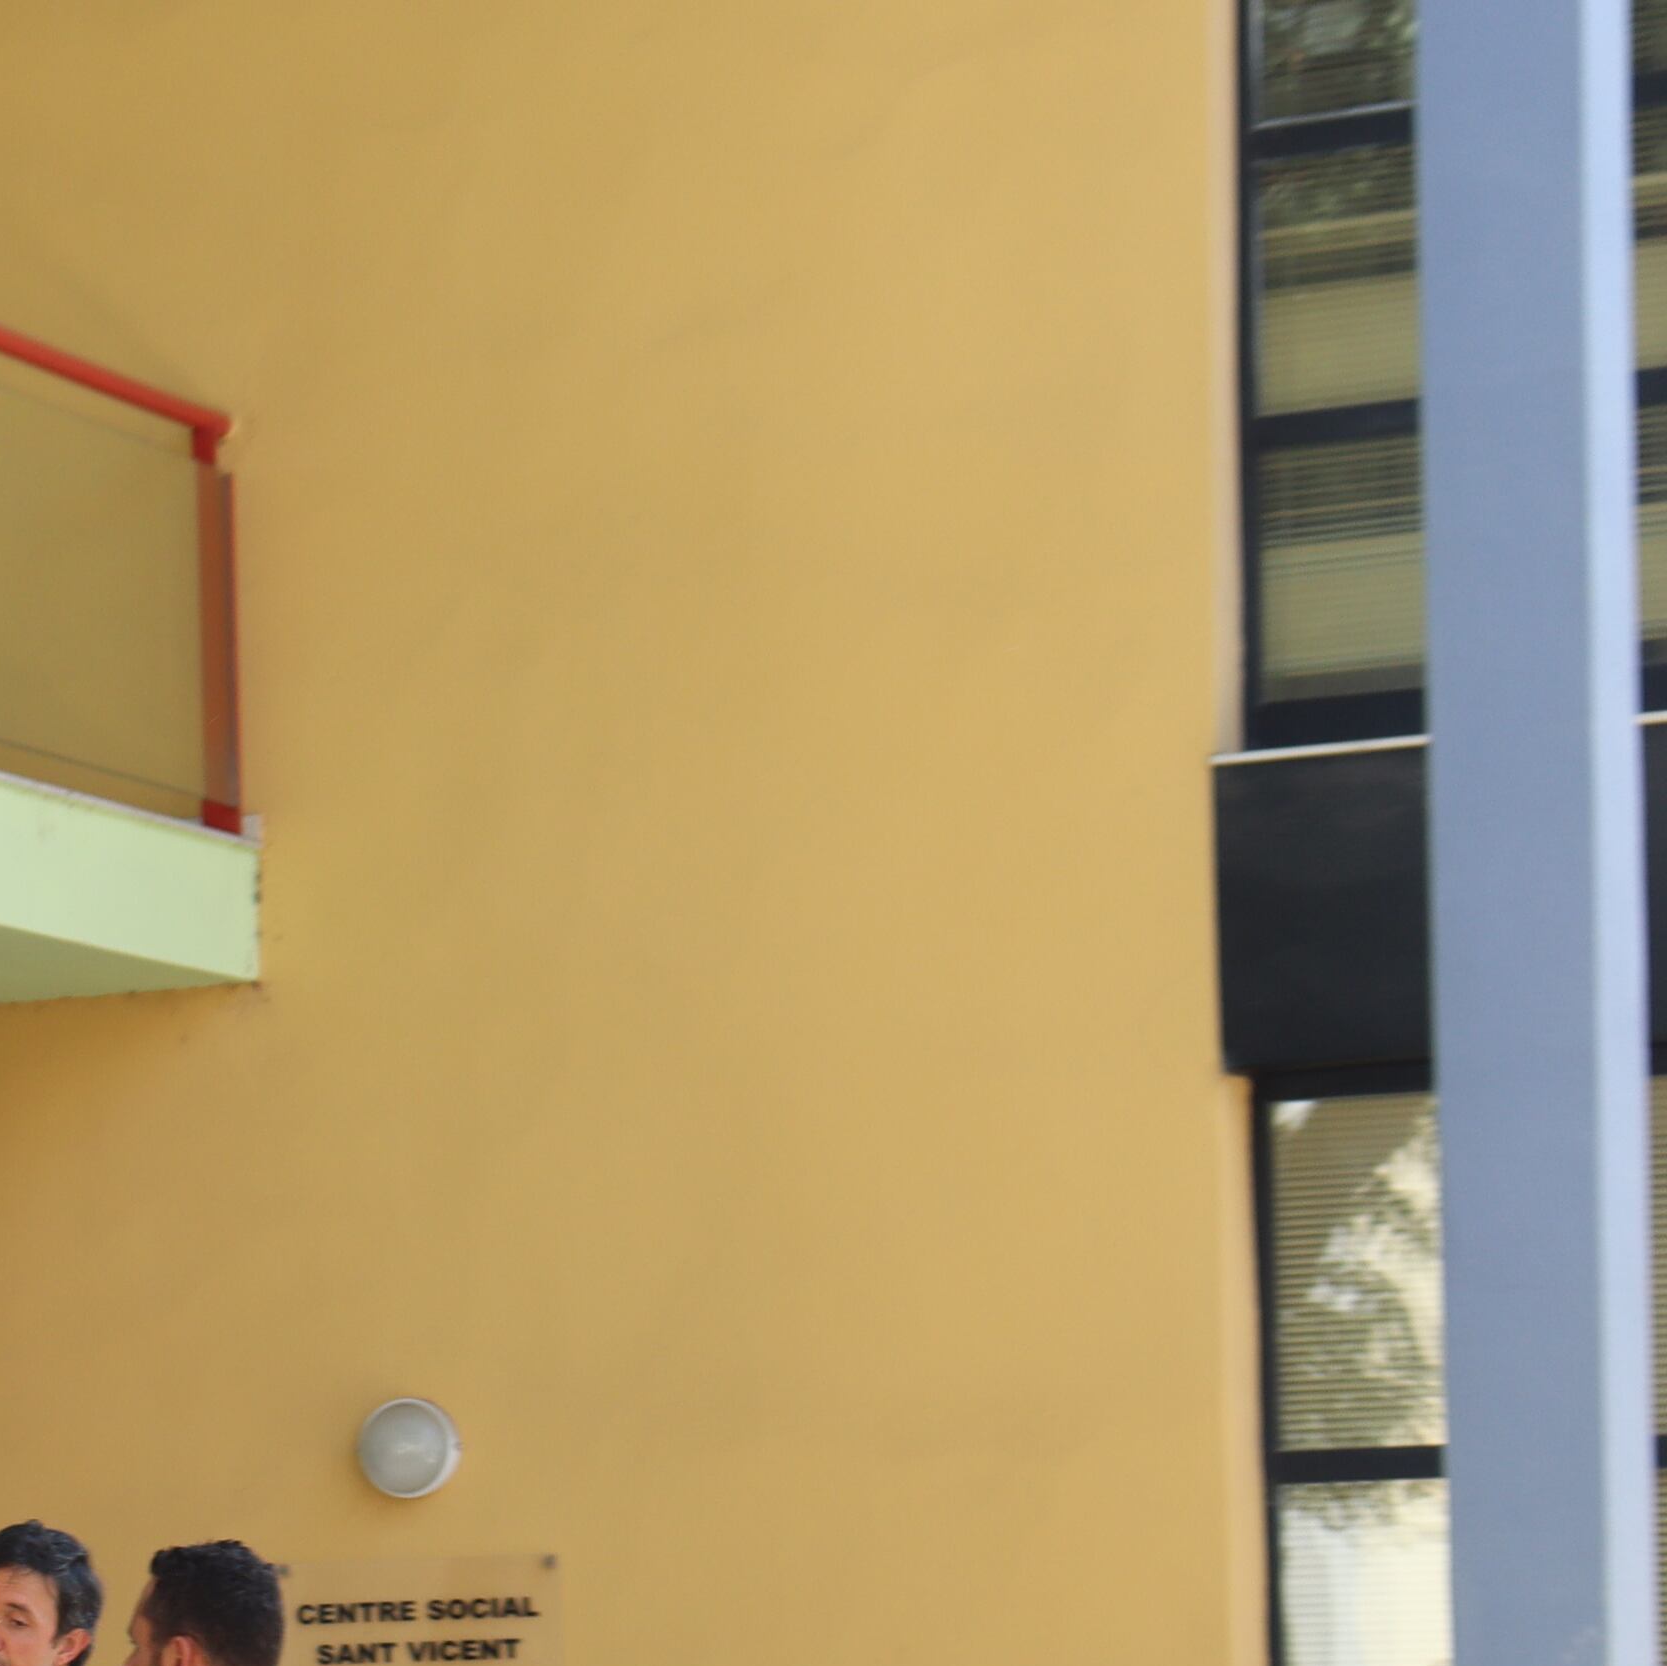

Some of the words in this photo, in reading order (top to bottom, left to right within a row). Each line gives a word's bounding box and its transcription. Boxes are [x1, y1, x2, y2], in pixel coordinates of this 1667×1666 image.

[297, 1601, 416, 1624] CENTRE
[427, 1597, 539, 1620] SOCIAL
[317, 1642, 396, 1664] SANT
[407, 1638, 520, 1662] VICENT
